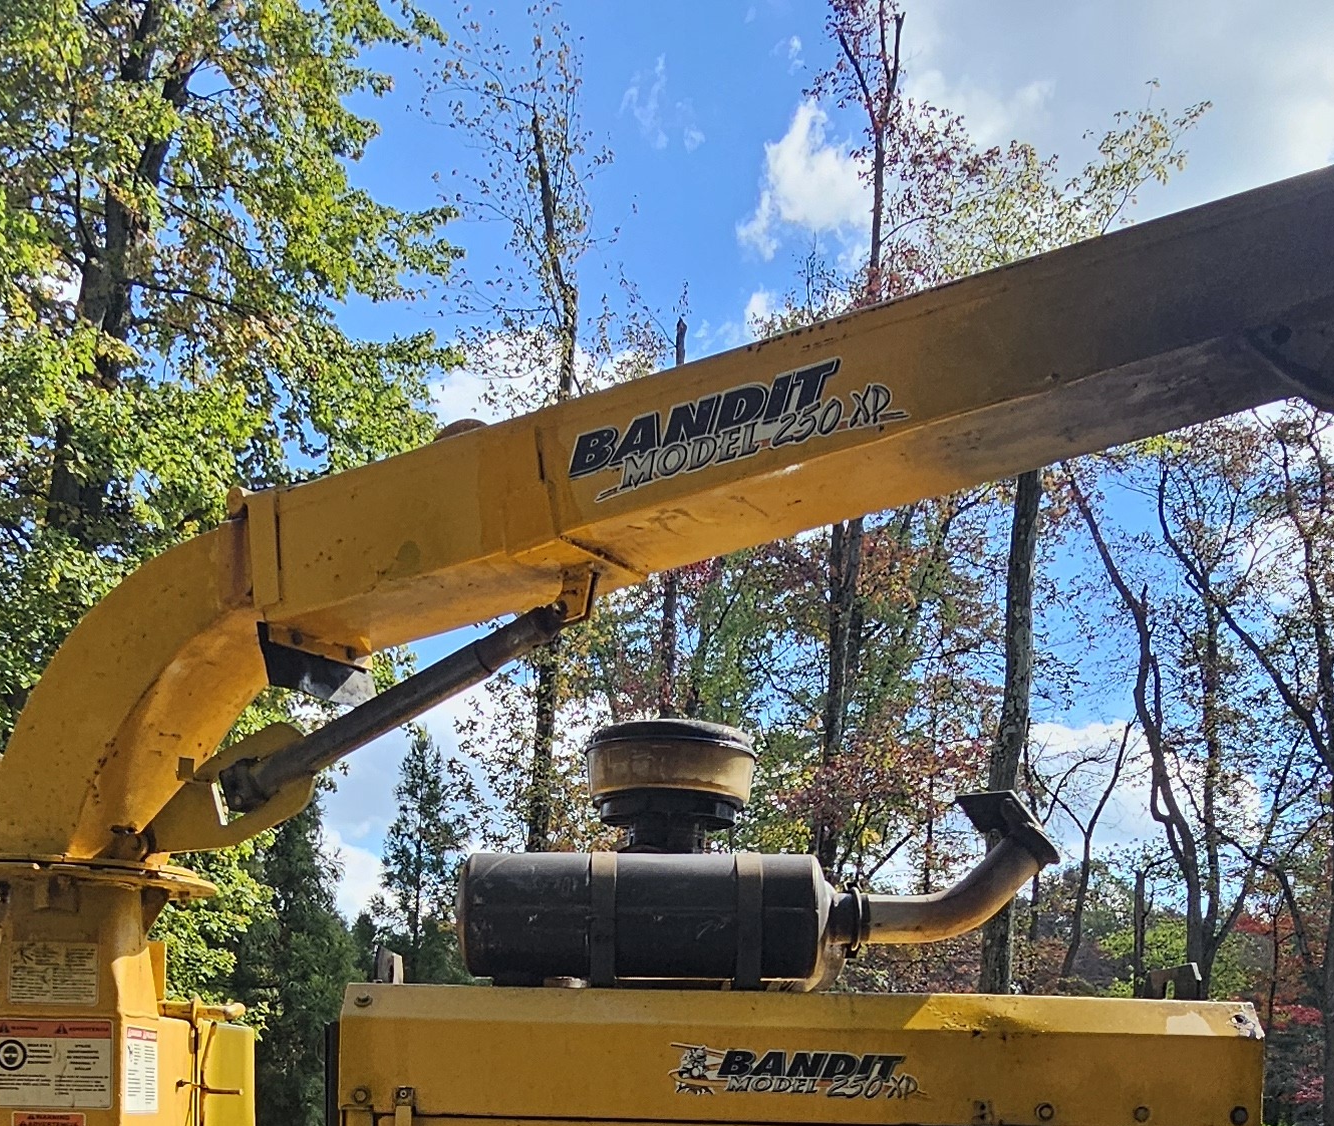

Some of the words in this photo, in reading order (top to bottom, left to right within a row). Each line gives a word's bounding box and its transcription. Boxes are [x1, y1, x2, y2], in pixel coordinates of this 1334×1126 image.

[568, 357, 842, 478] BANDIT
[618, 421, 761, 492] MODEL
[771, 396, 844, 450] 250
[848, 383, 894, 430] XP
[718, 1049, 907, 1081] BANDIT
[725, 1075, 820, 1095] MODEL
[826, 1074, 884, 1100] 250
[885, 1073, 918, 1101] XP
